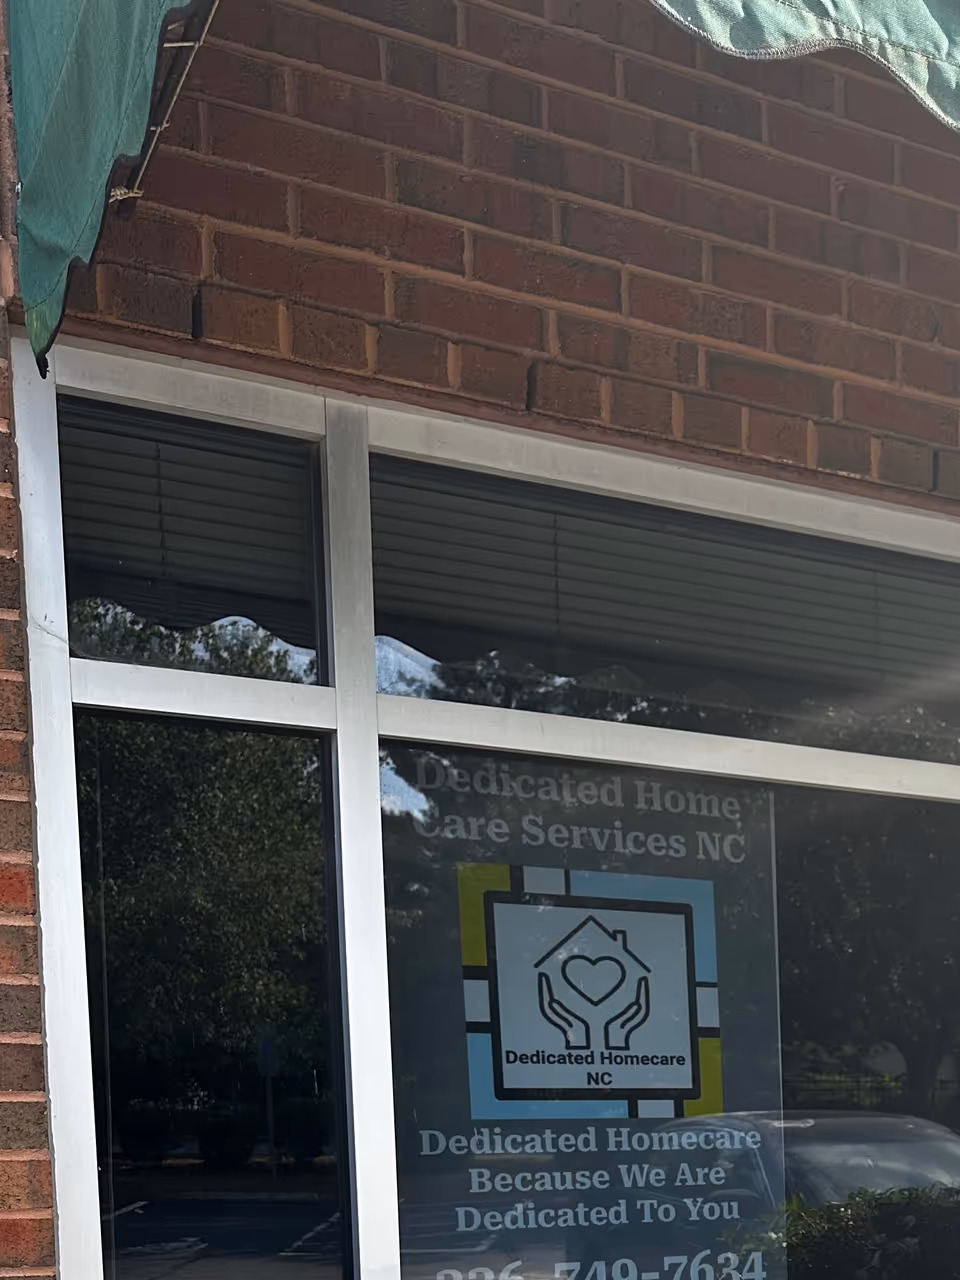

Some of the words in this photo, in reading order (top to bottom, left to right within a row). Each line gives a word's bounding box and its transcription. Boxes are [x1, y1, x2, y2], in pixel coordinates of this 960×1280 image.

[414, 757, 625, 808] Dedicated
[634, 780, 741, 820] Home
[414, 812, 510, 843] Care
[521, 815, 687, 857] Services
[696, 832, 746, 863] NC
[505, 1050, 595, 1066] Dedicated
[600, 1051, 686, 1066] Homecare
[586, 1071, 613, 1086] NC
[419, 1127, 598, 1156] Dedicated
[607, 1126, 762, 1152] Homecare
[468, 1167, 610, 1194] Because
[619, 1164, 666, 1187] We
[674, 1163, 726, 1186] Are
[455, 1200, 629, 1232] Dedicated
[637, 1199, 676, 1223] To
[683, 1198, 740, 1221] You
